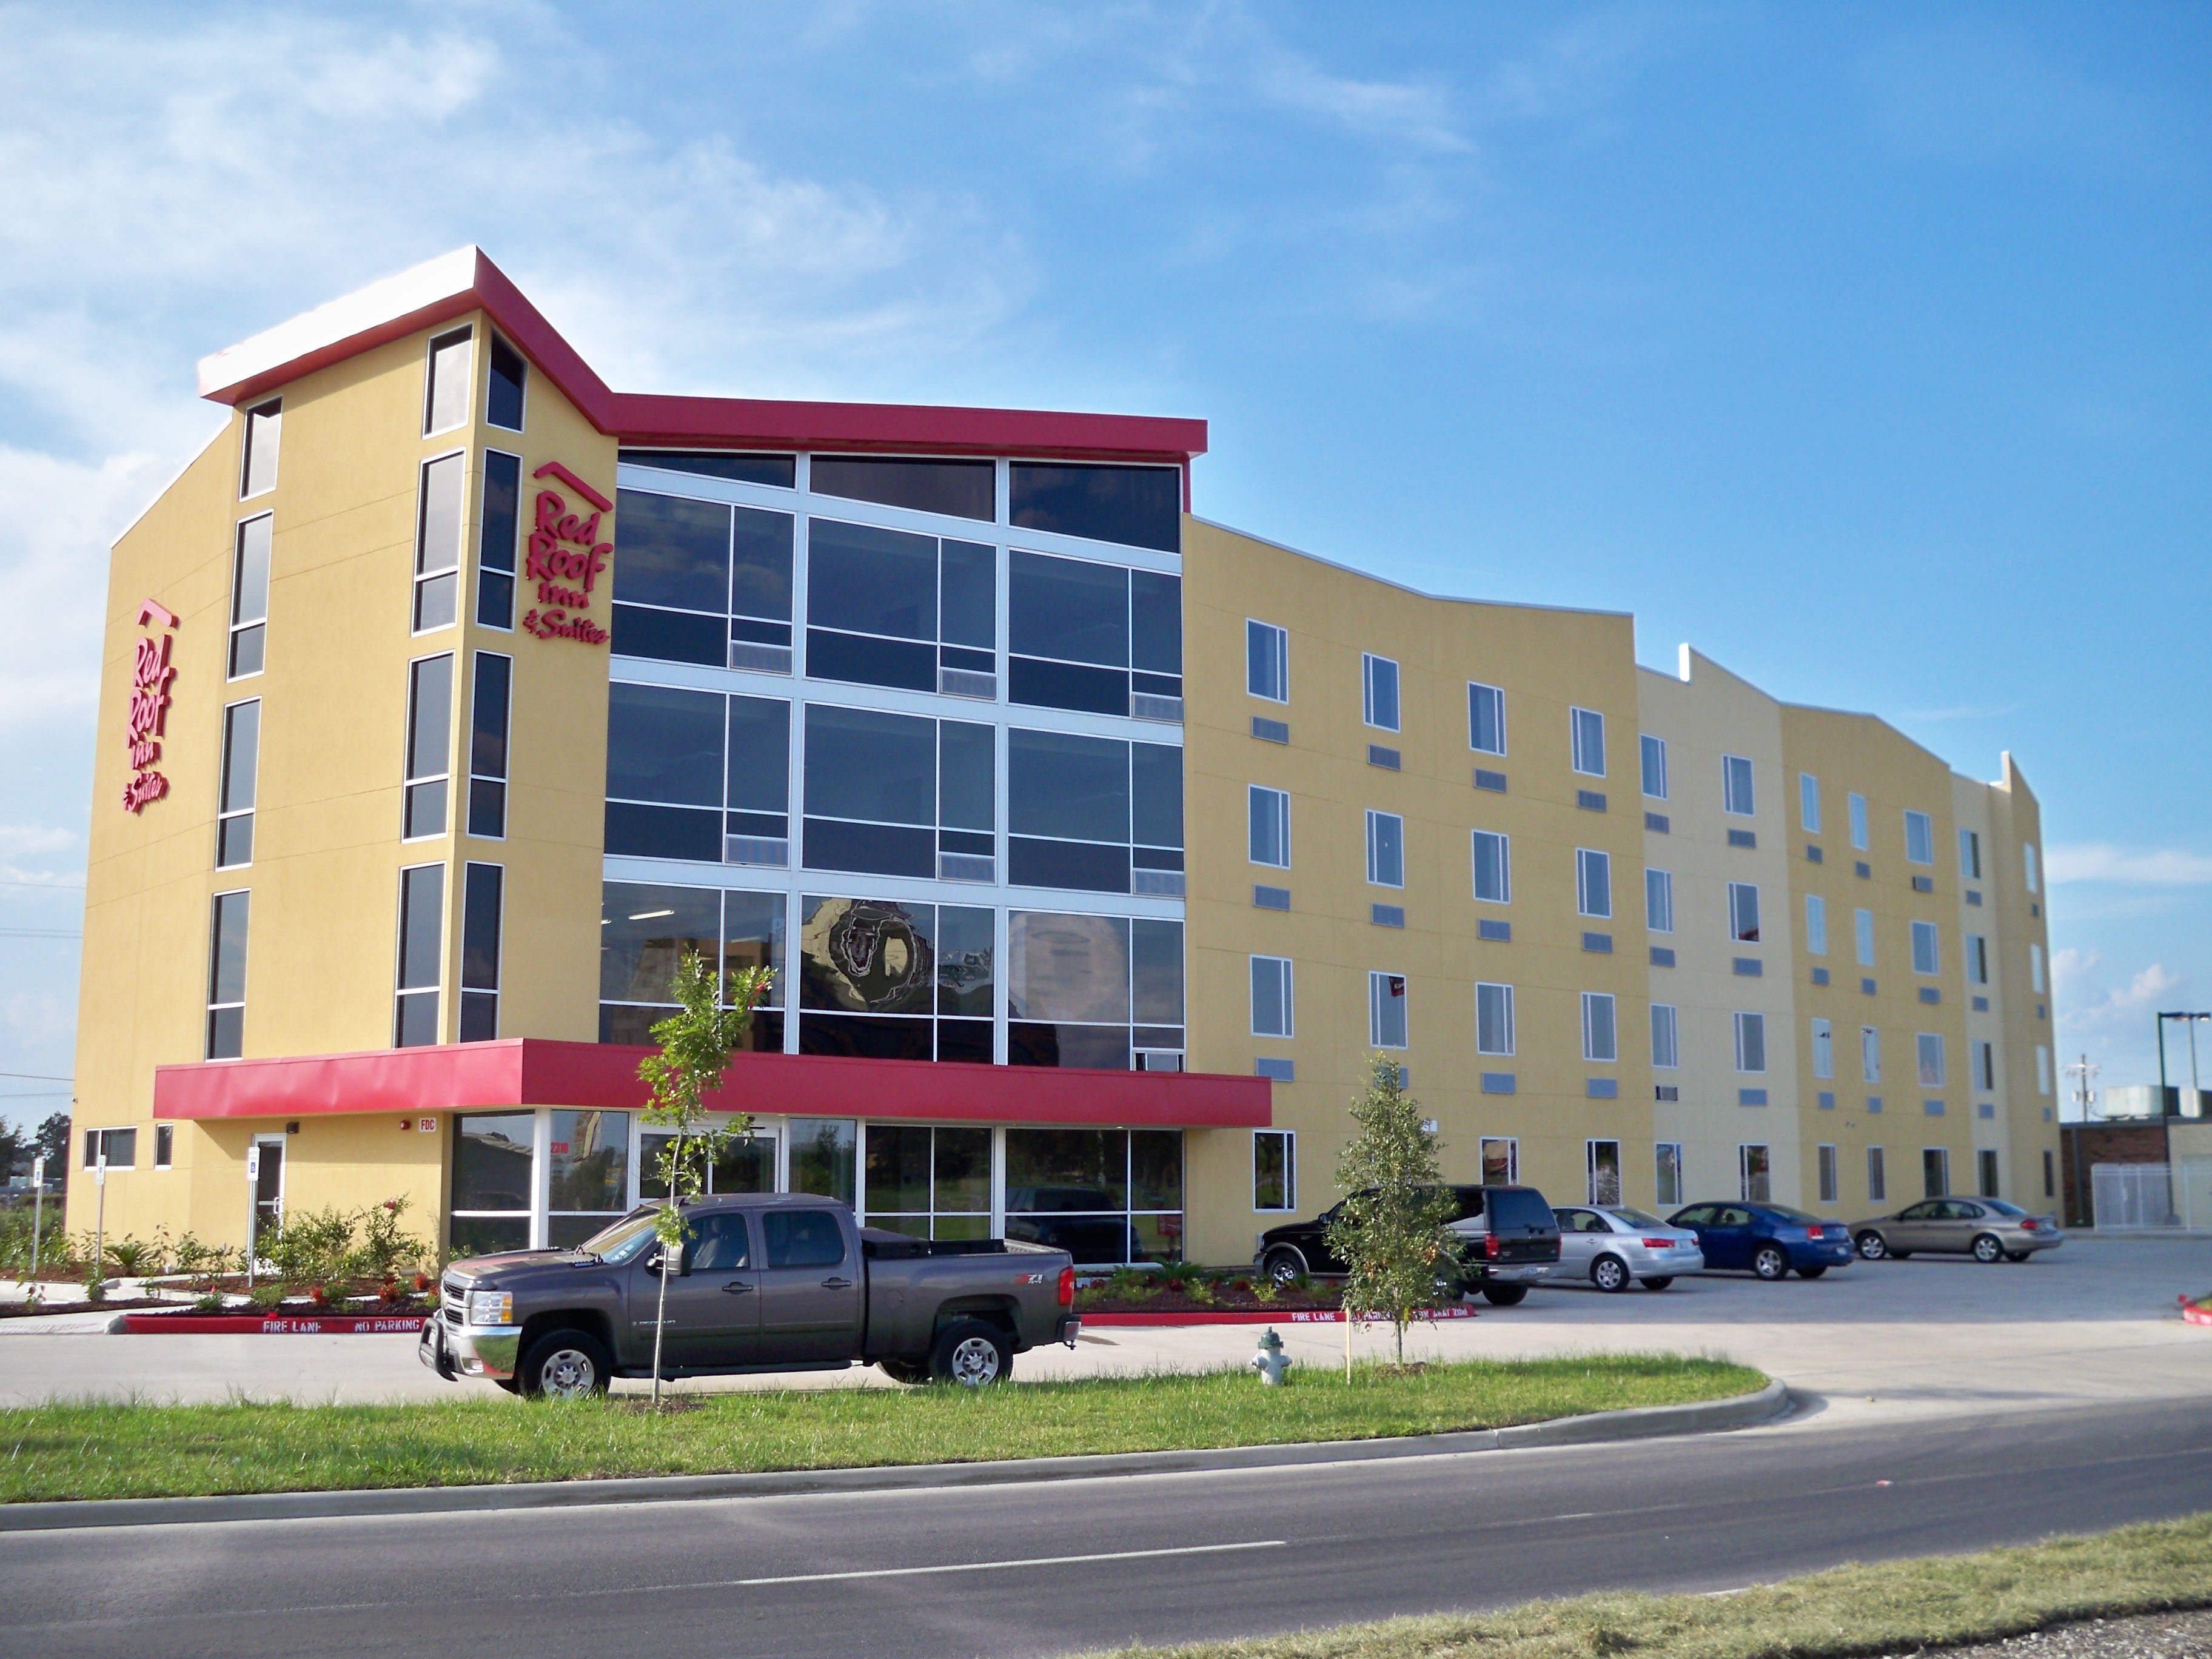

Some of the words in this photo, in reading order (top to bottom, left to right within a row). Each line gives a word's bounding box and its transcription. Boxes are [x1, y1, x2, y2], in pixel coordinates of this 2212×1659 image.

[535, 490, 601, 545] Red
[526, 531, 614, 592] Roof
[536, 608, 611, 645] Suites
[134, 634, 169, 688] Red
[127, 667, 173, 748] Roof
[129, 770, 165, 813] Suites
[421, 1119, 435, 1130] FDC
[263, 1321, 287, 1333] FIRE
[355, 1322, 369, 1332] NO
[374, 1319, 420, 1331] PARKING
[1292, 1312, 1310, 1322] FIRE
[1313, 1312, 1335, 1321] LANE
